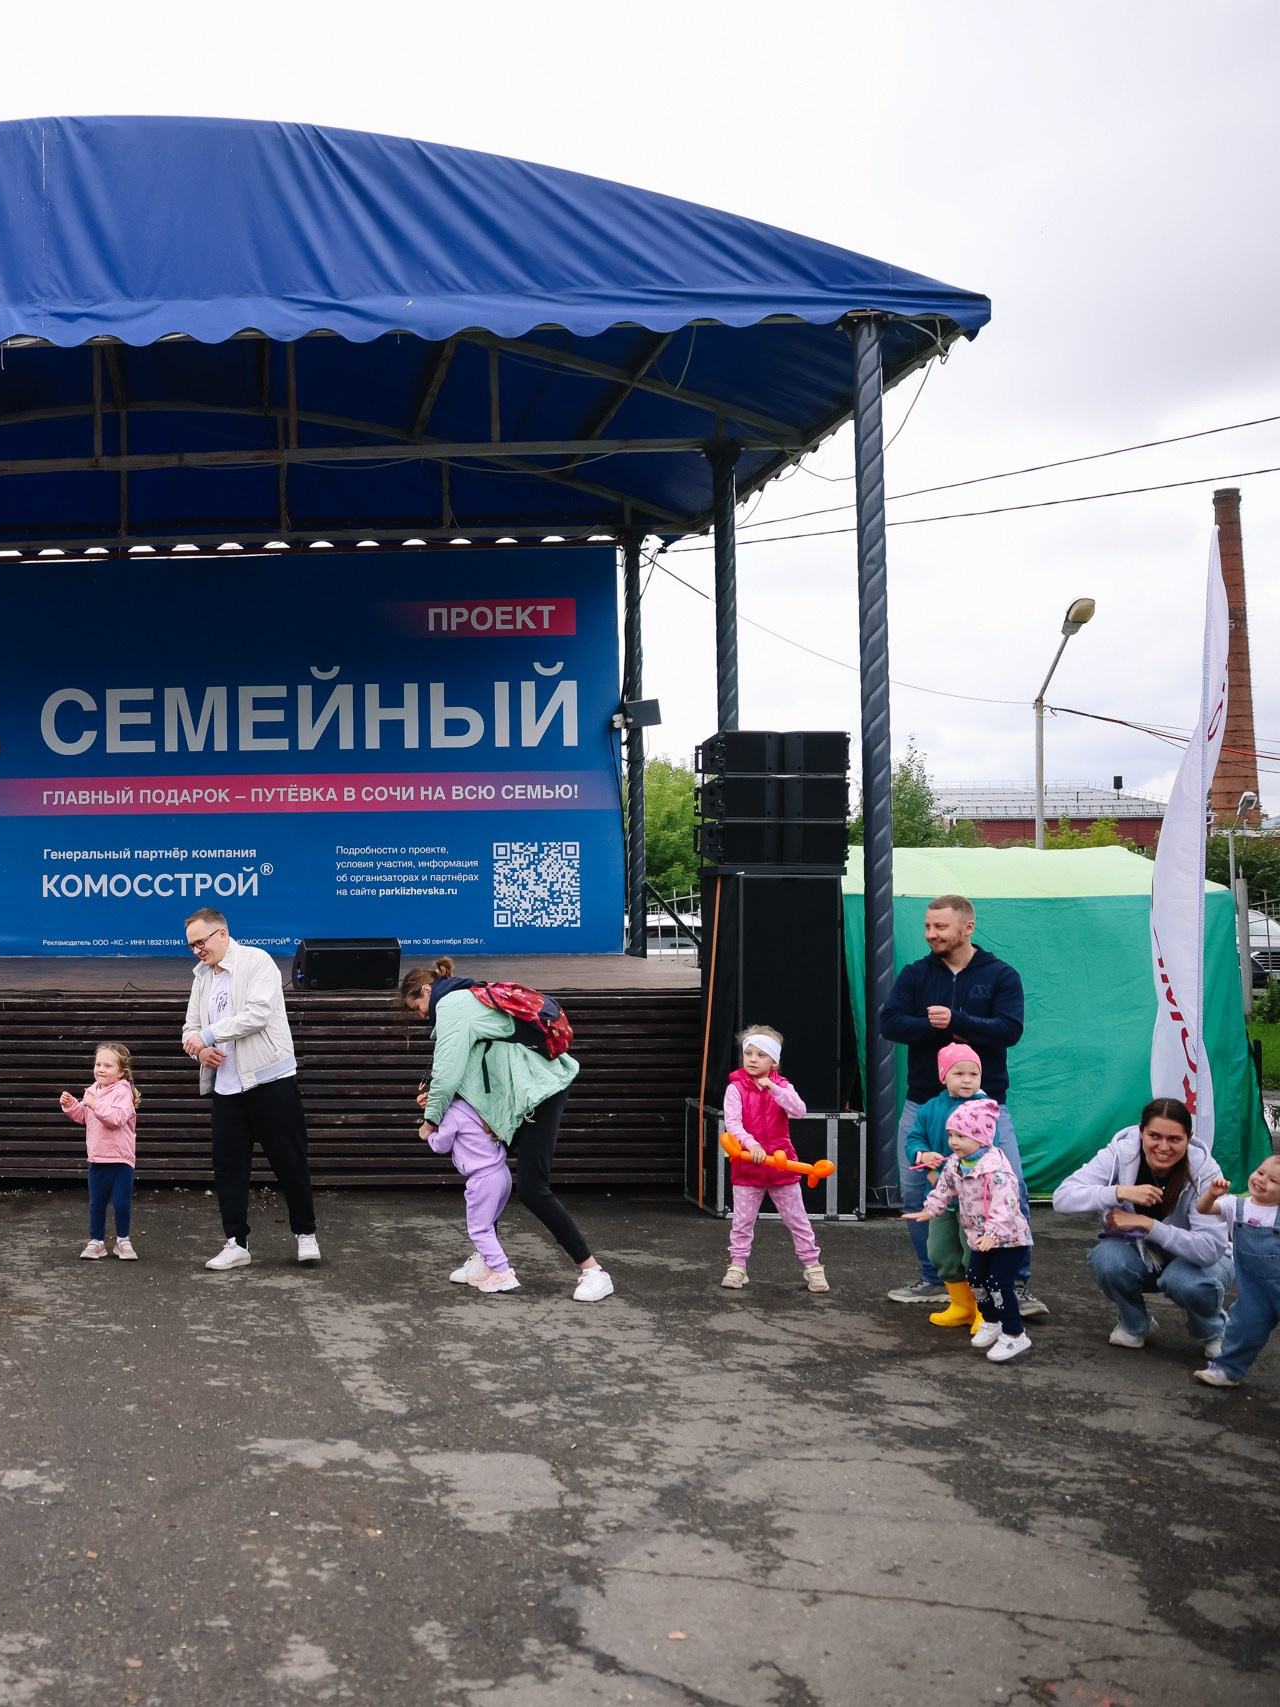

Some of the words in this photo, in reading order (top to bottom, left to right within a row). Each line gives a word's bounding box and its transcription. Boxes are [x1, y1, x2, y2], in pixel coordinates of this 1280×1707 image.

[427, 605, 556, 631] ПРОЕКТ
[40, 661, 579, 756] СЕМЕЙНЫЙ
[42, 786, 134, 806] ГЛАВНЫЙ
[139, 788, 231, 806] ПОДАРОК
[251, 784, 338, 803] ПУТЁВКА
[343, 787, 356, 802] В
[361, 786, 415, 802] СОЧИ
[420, 785, 446, 801] НА
[451, 785, 496, 800] ВСЮ
[501, 783, 579, 800] СЕМЬЮ!
[43, 847, 131, 862] Генеральный
[134, 847, 188, 861] партнёр
[192, 847, 257, 858] компания
[335, 845, 398, 857] Подробности
[408, 846, 449, 856] проекте,
[335, 861, 374, 870] условия
[376, 860, 416, 870] участия,
[418, 858, 479, 869] информация
[335, 873, 348, 882] об
[350, 874, 419, 884] организаторах
[430, 872, 480, 883] партнёрах
[336, 888, 348, 896] на
[350, 886, 377, 896] сайте
[379, 886, 458, 898] parkiizhevska.ru
[42, 939, 92, 947] Рекламодатель
[130, 938, 146, 946] ИНН
[432, 938, 462, 946] сентября
